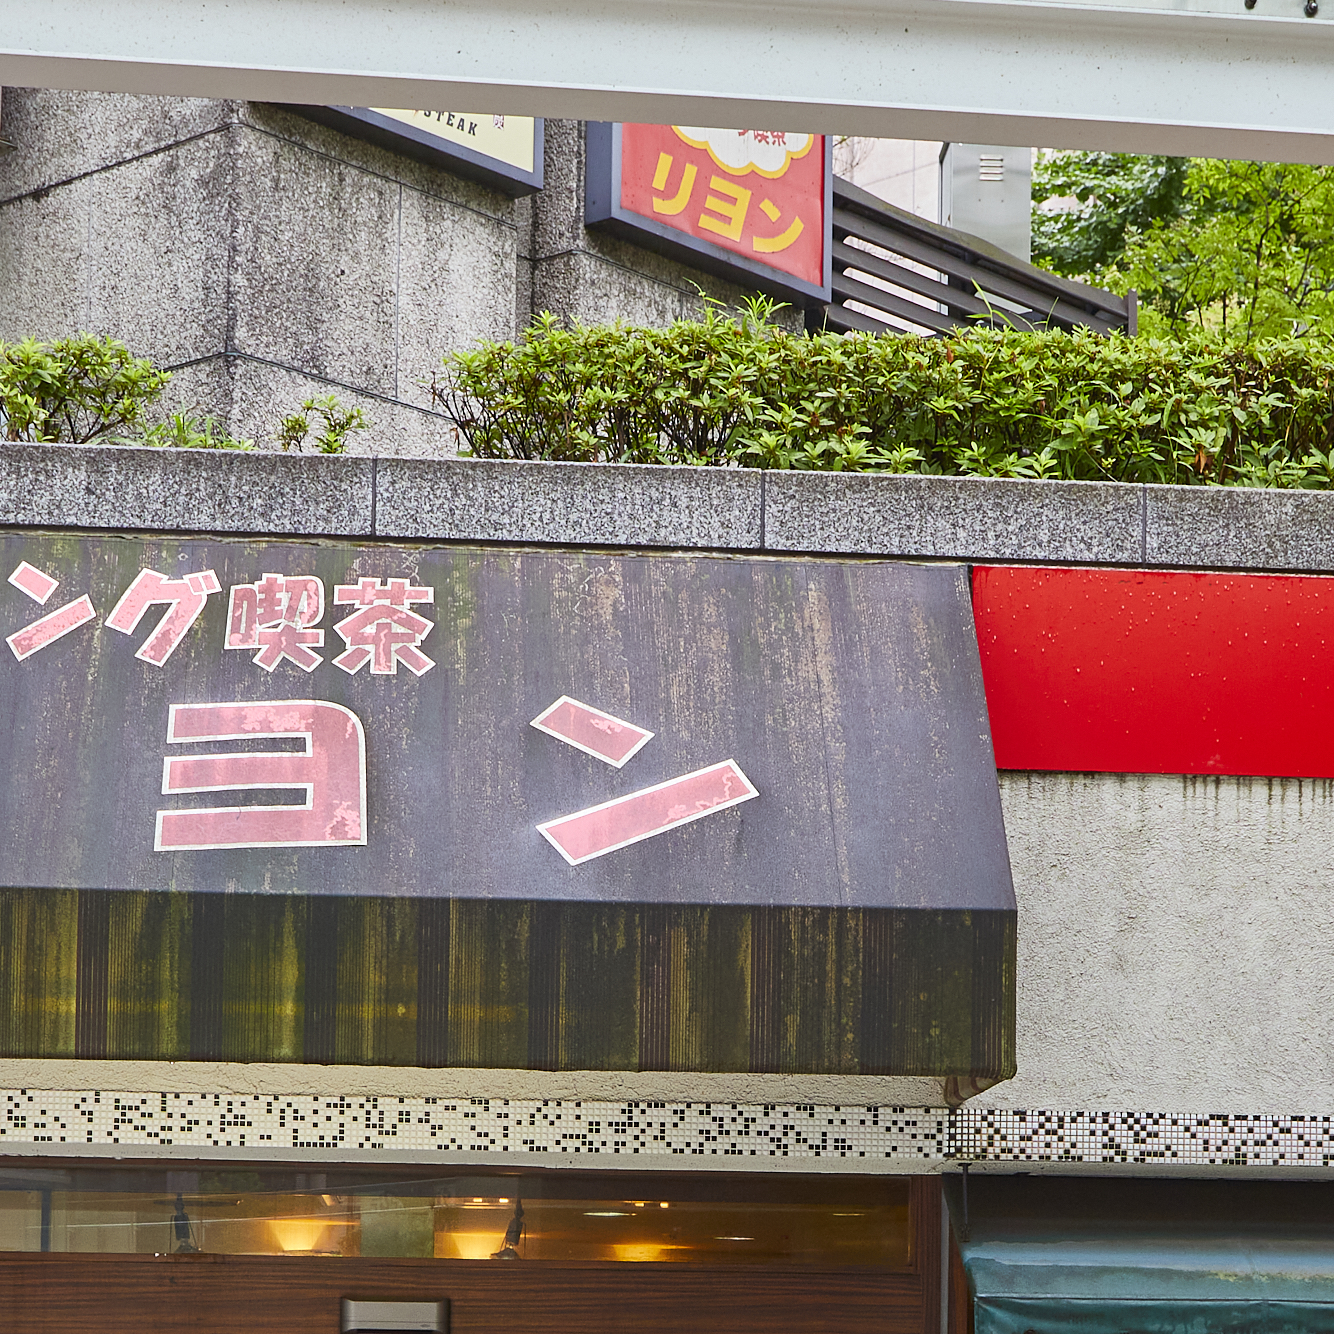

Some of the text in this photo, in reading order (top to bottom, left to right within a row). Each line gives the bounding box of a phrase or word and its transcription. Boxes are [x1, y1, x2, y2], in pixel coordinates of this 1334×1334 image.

[423, 110, 478, 136] STEAK
[652, 152, 804, 253] リヨン
